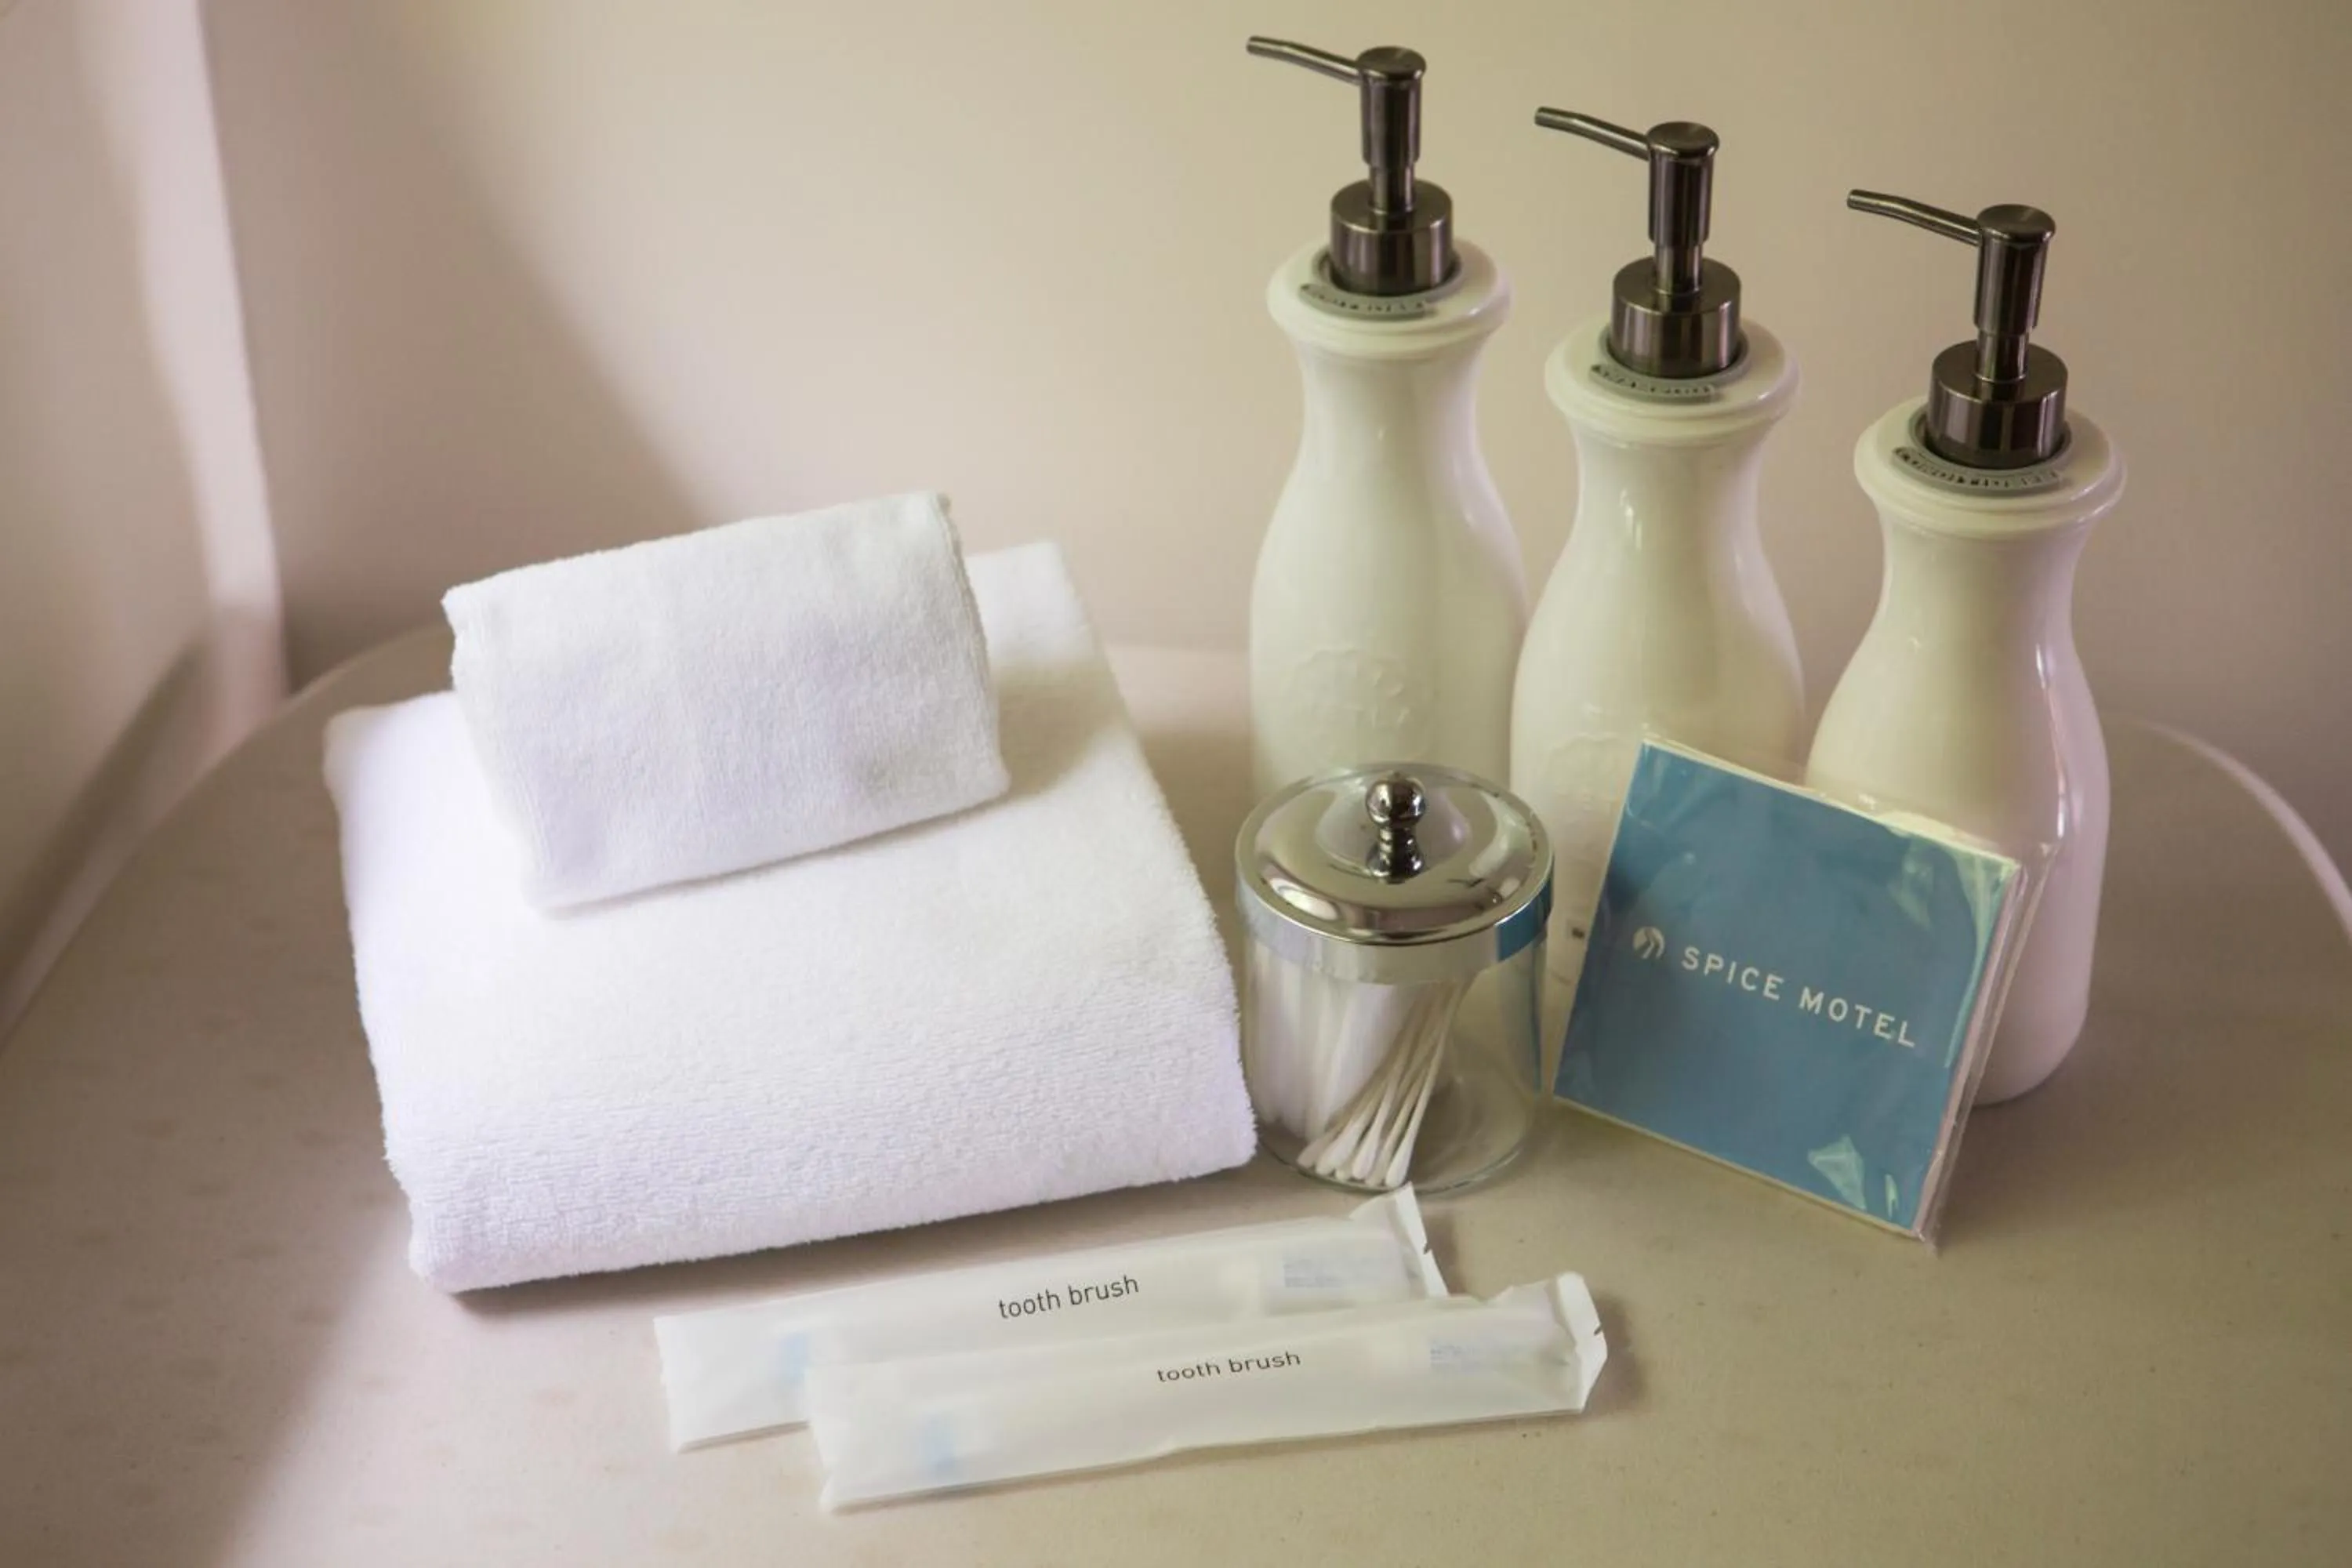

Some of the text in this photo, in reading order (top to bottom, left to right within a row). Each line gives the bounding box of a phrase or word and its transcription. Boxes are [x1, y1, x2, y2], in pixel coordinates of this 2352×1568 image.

[1680, 946, 1915, 1048] SPICE MOTEL
[998, 1275, 1139, 1319] tooth brush
[1156, 1351, 1301, 1382] tooth brush
